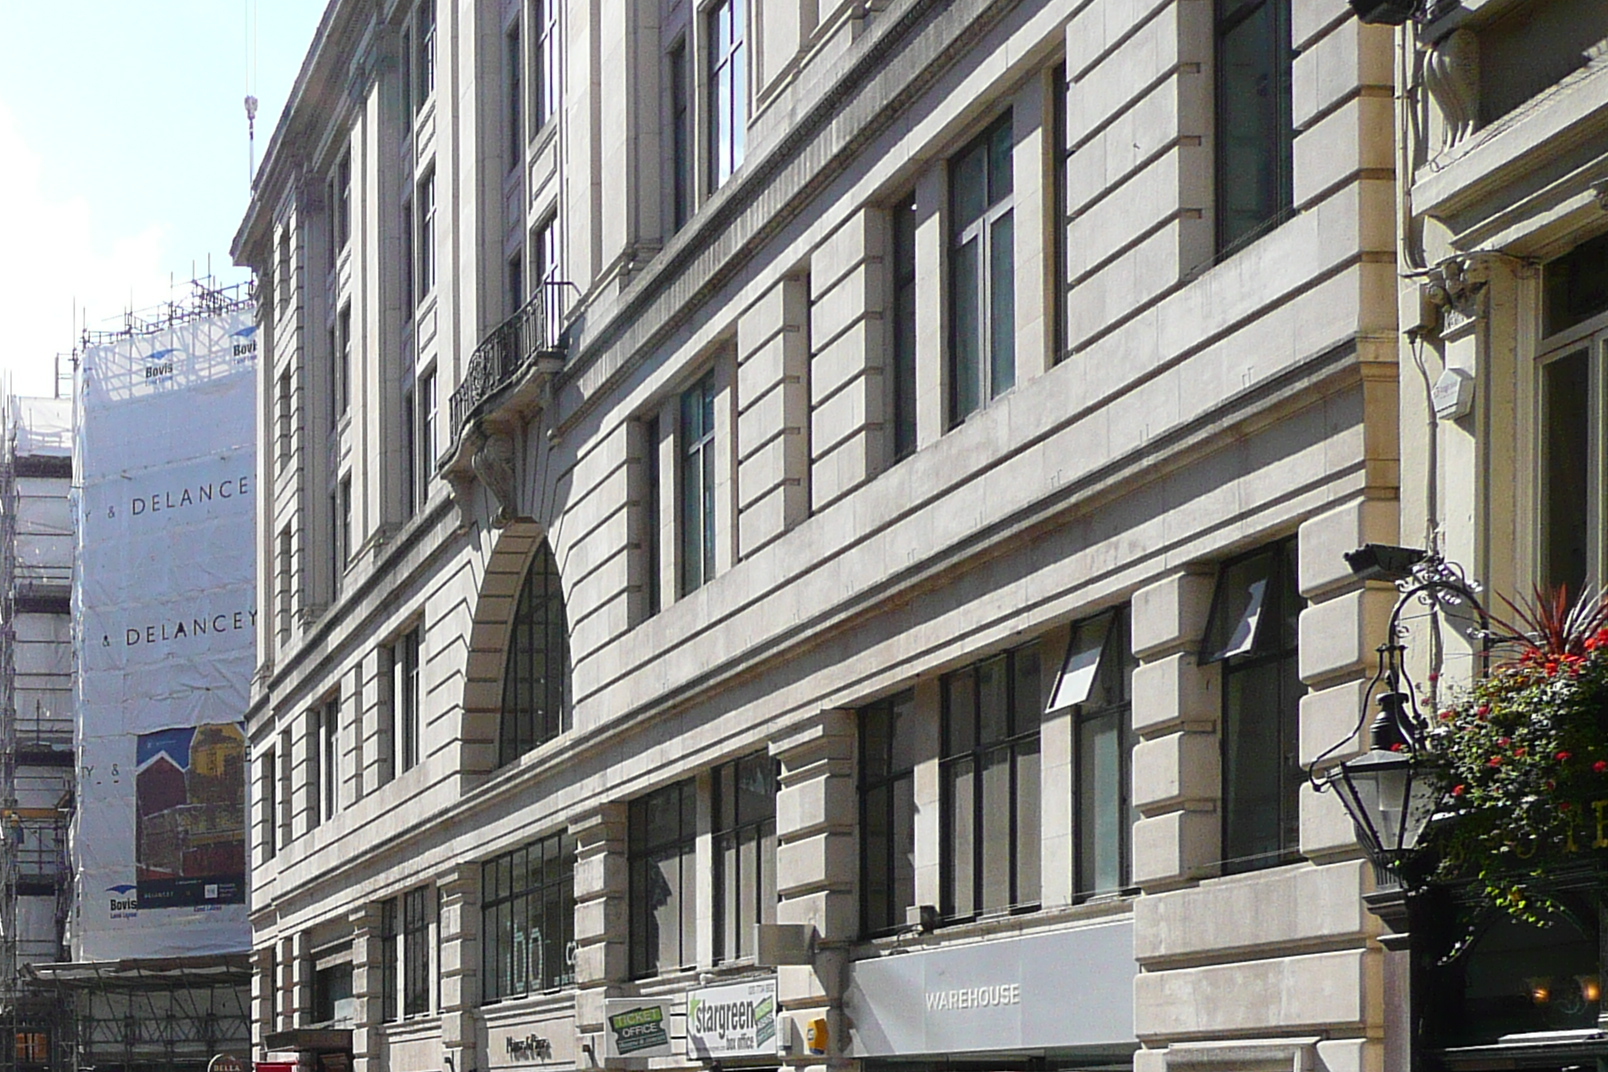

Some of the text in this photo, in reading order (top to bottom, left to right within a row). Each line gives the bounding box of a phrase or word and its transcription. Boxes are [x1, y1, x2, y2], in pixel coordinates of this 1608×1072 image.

[233, 340, 258, 357] Bovi
[145, 363, 173, 379] Bovis
[107, 475, 257, 519] & DELANCE
[102, 609, 258, 647] & DELANCEY
[110, 898, 138, 911] Bovis
[925, 983, 1021, 1012] WAREHOUSE
[613, 1009, 660, 1028] TICKET
[695, 1000, 754, 1040] stargreen
[622, 1021, 659, 1038] OFFICE
[726, 1032, 754, 1051] box office
[213, 1064, 241, 1072] BELLA
